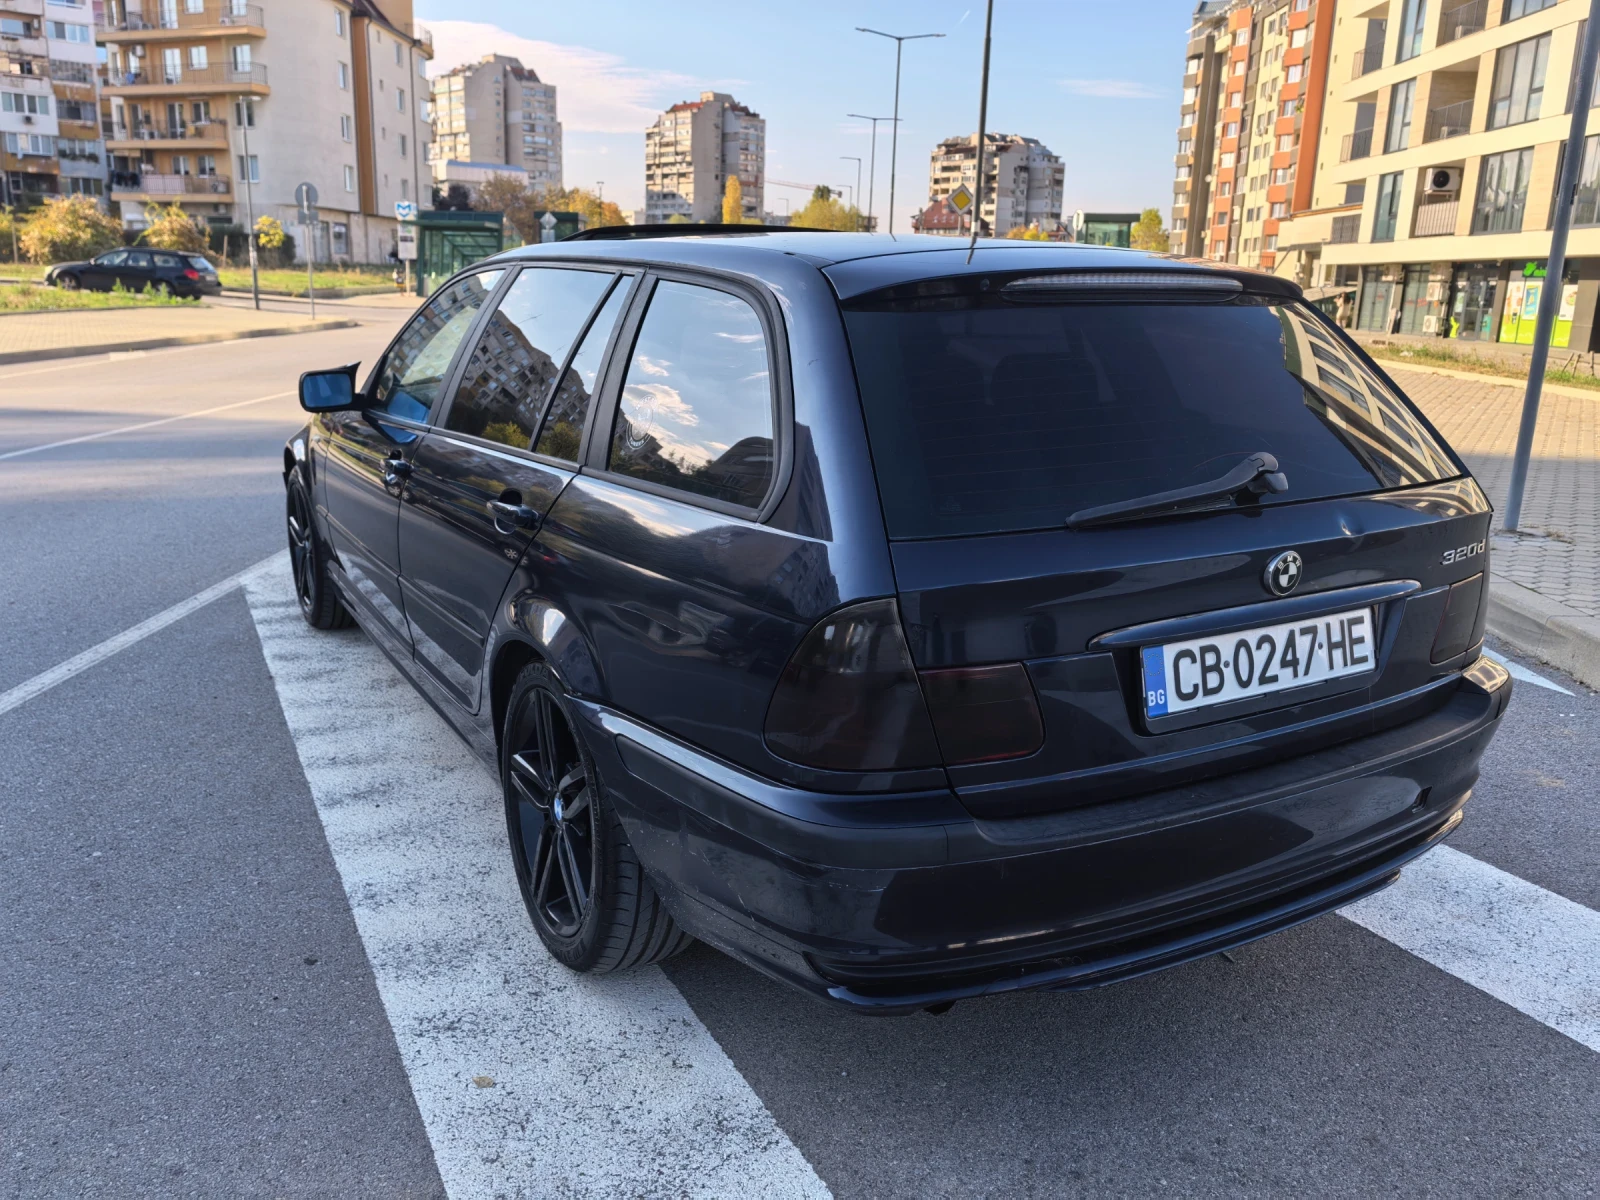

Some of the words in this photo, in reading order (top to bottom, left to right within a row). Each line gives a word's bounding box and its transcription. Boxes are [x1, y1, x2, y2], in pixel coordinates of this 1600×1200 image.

[1442, 539, 1486, 565] 320d
[1277, 555, 1301, 570] BMW
[1148, 689, 1165, 707] BG
